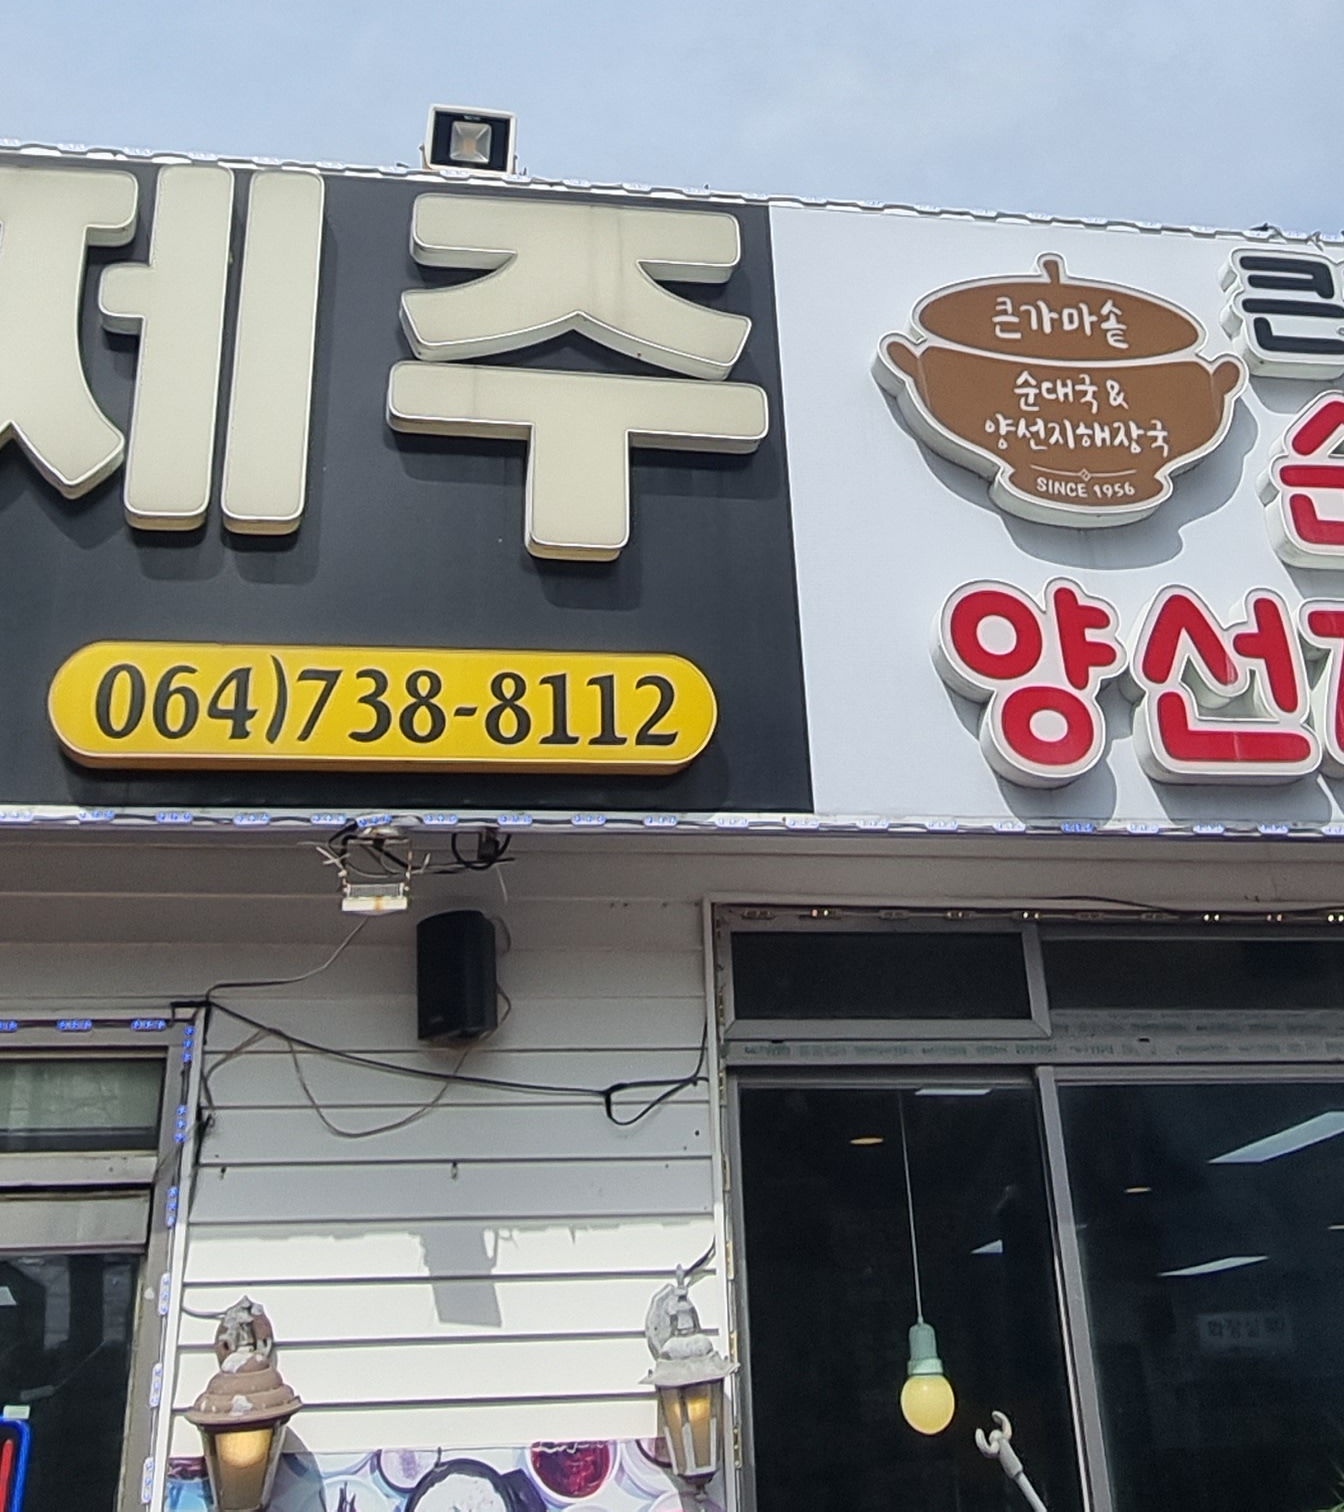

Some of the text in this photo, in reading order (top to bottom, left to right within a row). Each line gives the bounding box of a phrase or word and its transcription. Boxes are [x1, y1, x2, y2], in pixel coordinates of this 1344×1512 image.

[991, 295, 1130, 350] 큰가마솥
[1013, 370, 1130, 414] 순대국 &
[984, 413, 1170, 457] 양선지해장국
[1036, 477, 1136, 498] SINCE 1956
[93, 661, 680, 748] 064)738-8112
